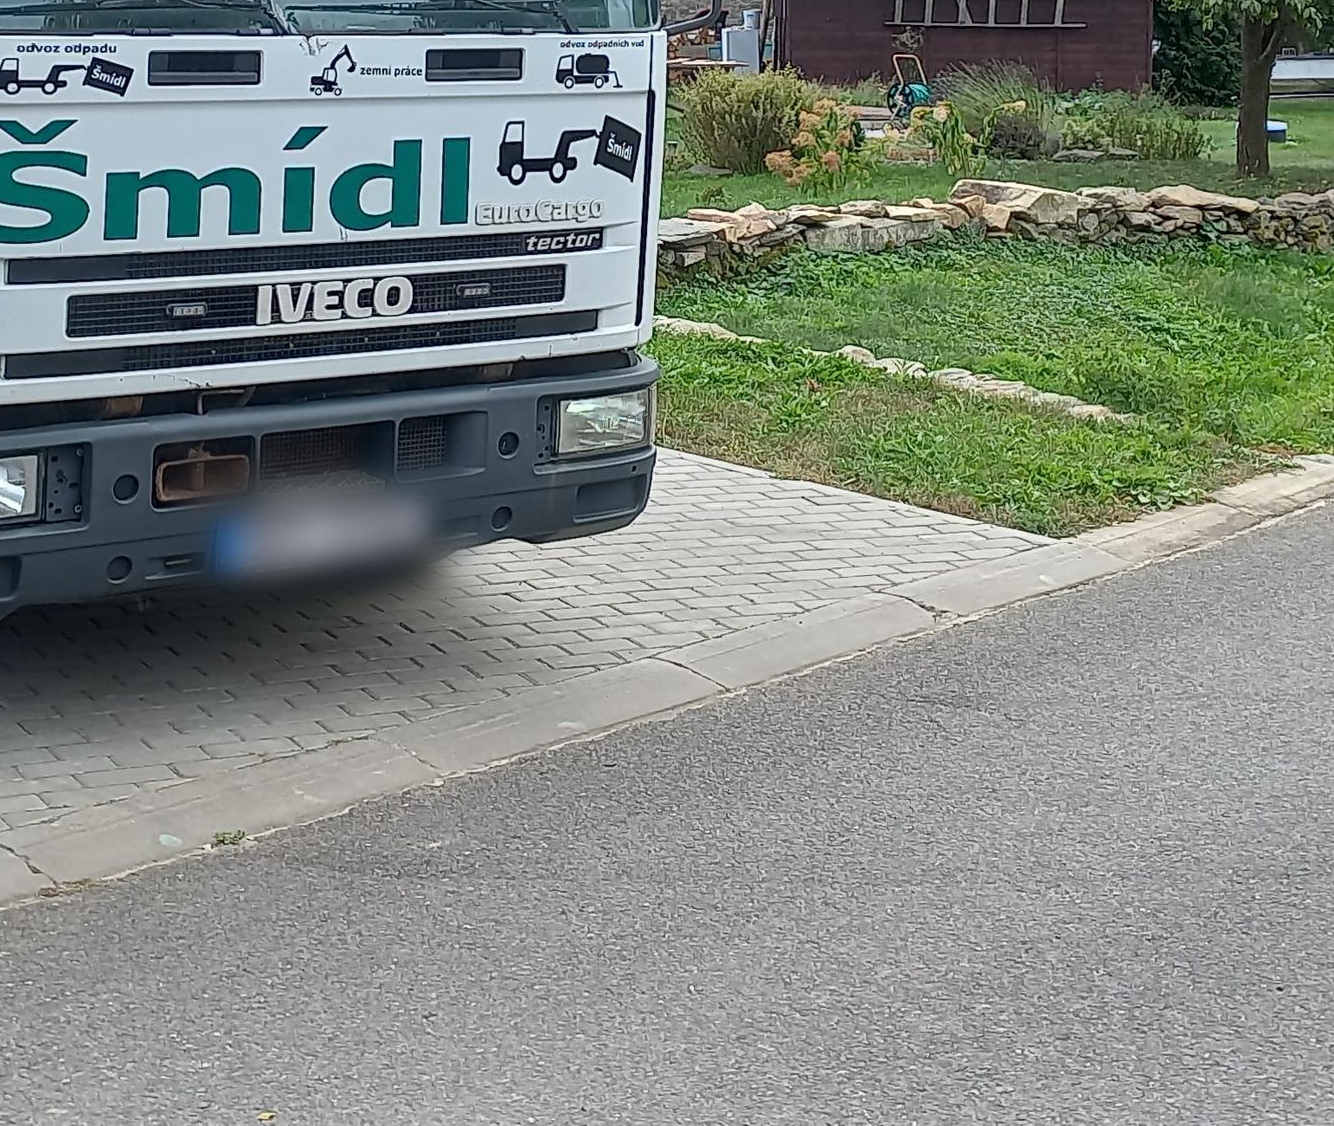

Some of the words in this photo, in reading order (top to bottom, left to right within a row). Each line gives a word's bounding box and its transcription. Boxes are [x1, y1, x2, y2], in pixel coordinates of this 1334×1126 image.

[16, 42, 61, 54] odvoz
[64, 43, 117, 55] odpadu
[560, 40, 585, 48] odvoz
[587, 39, 629, 49] odpadních
[90, 64, 127, 88] Šmídl
[359, 65, 391, 76] zemní
[394, 65, 423, 77] práce
[606, 132, 634, 162] Šmídl
[475, 198, 605, 225] EuroCargo
[526, 232, 601, 252] tector
[256, 276, 414, 325] IVECO
